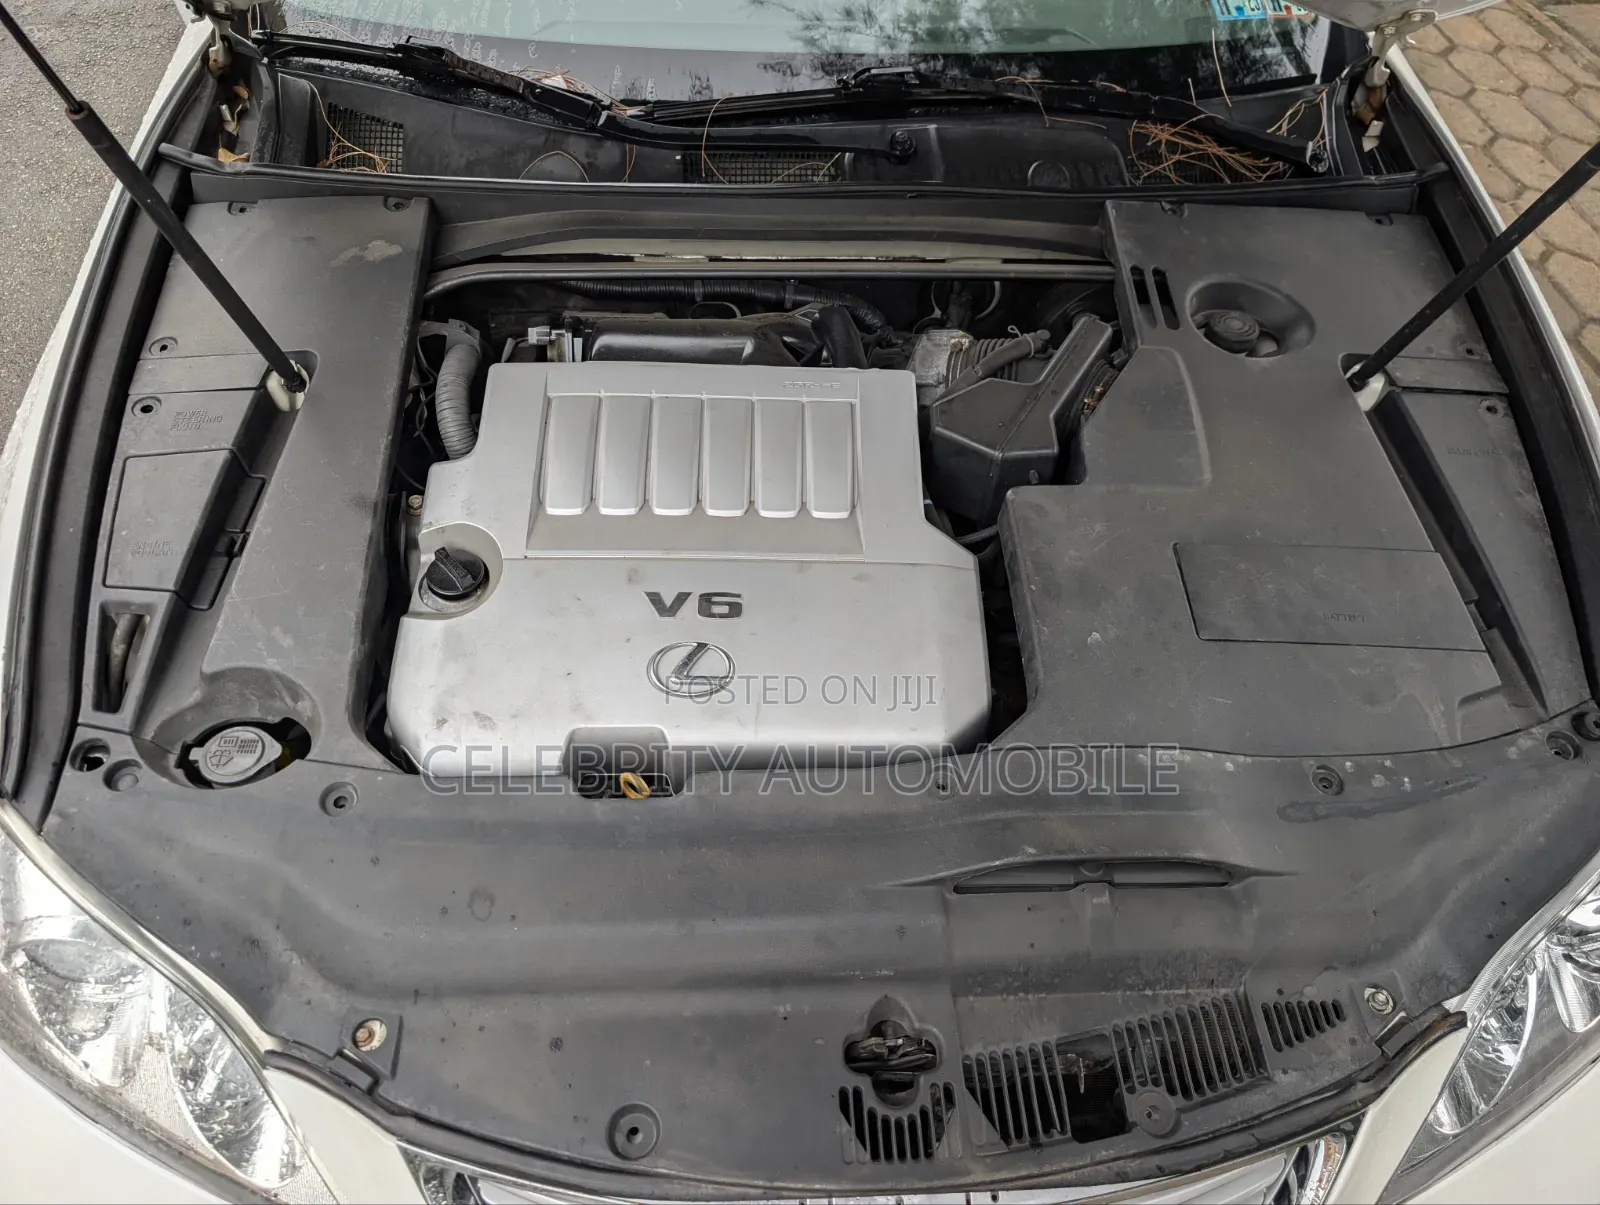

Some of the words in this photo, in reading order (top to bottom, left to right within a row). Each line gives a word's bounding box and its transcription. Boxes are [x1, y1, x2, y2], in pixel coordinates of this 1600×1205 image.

[174, 409, 208, 418] POWER
[172, 415, 223, 424] STEERING
[642, 591, 744, 619] V6
